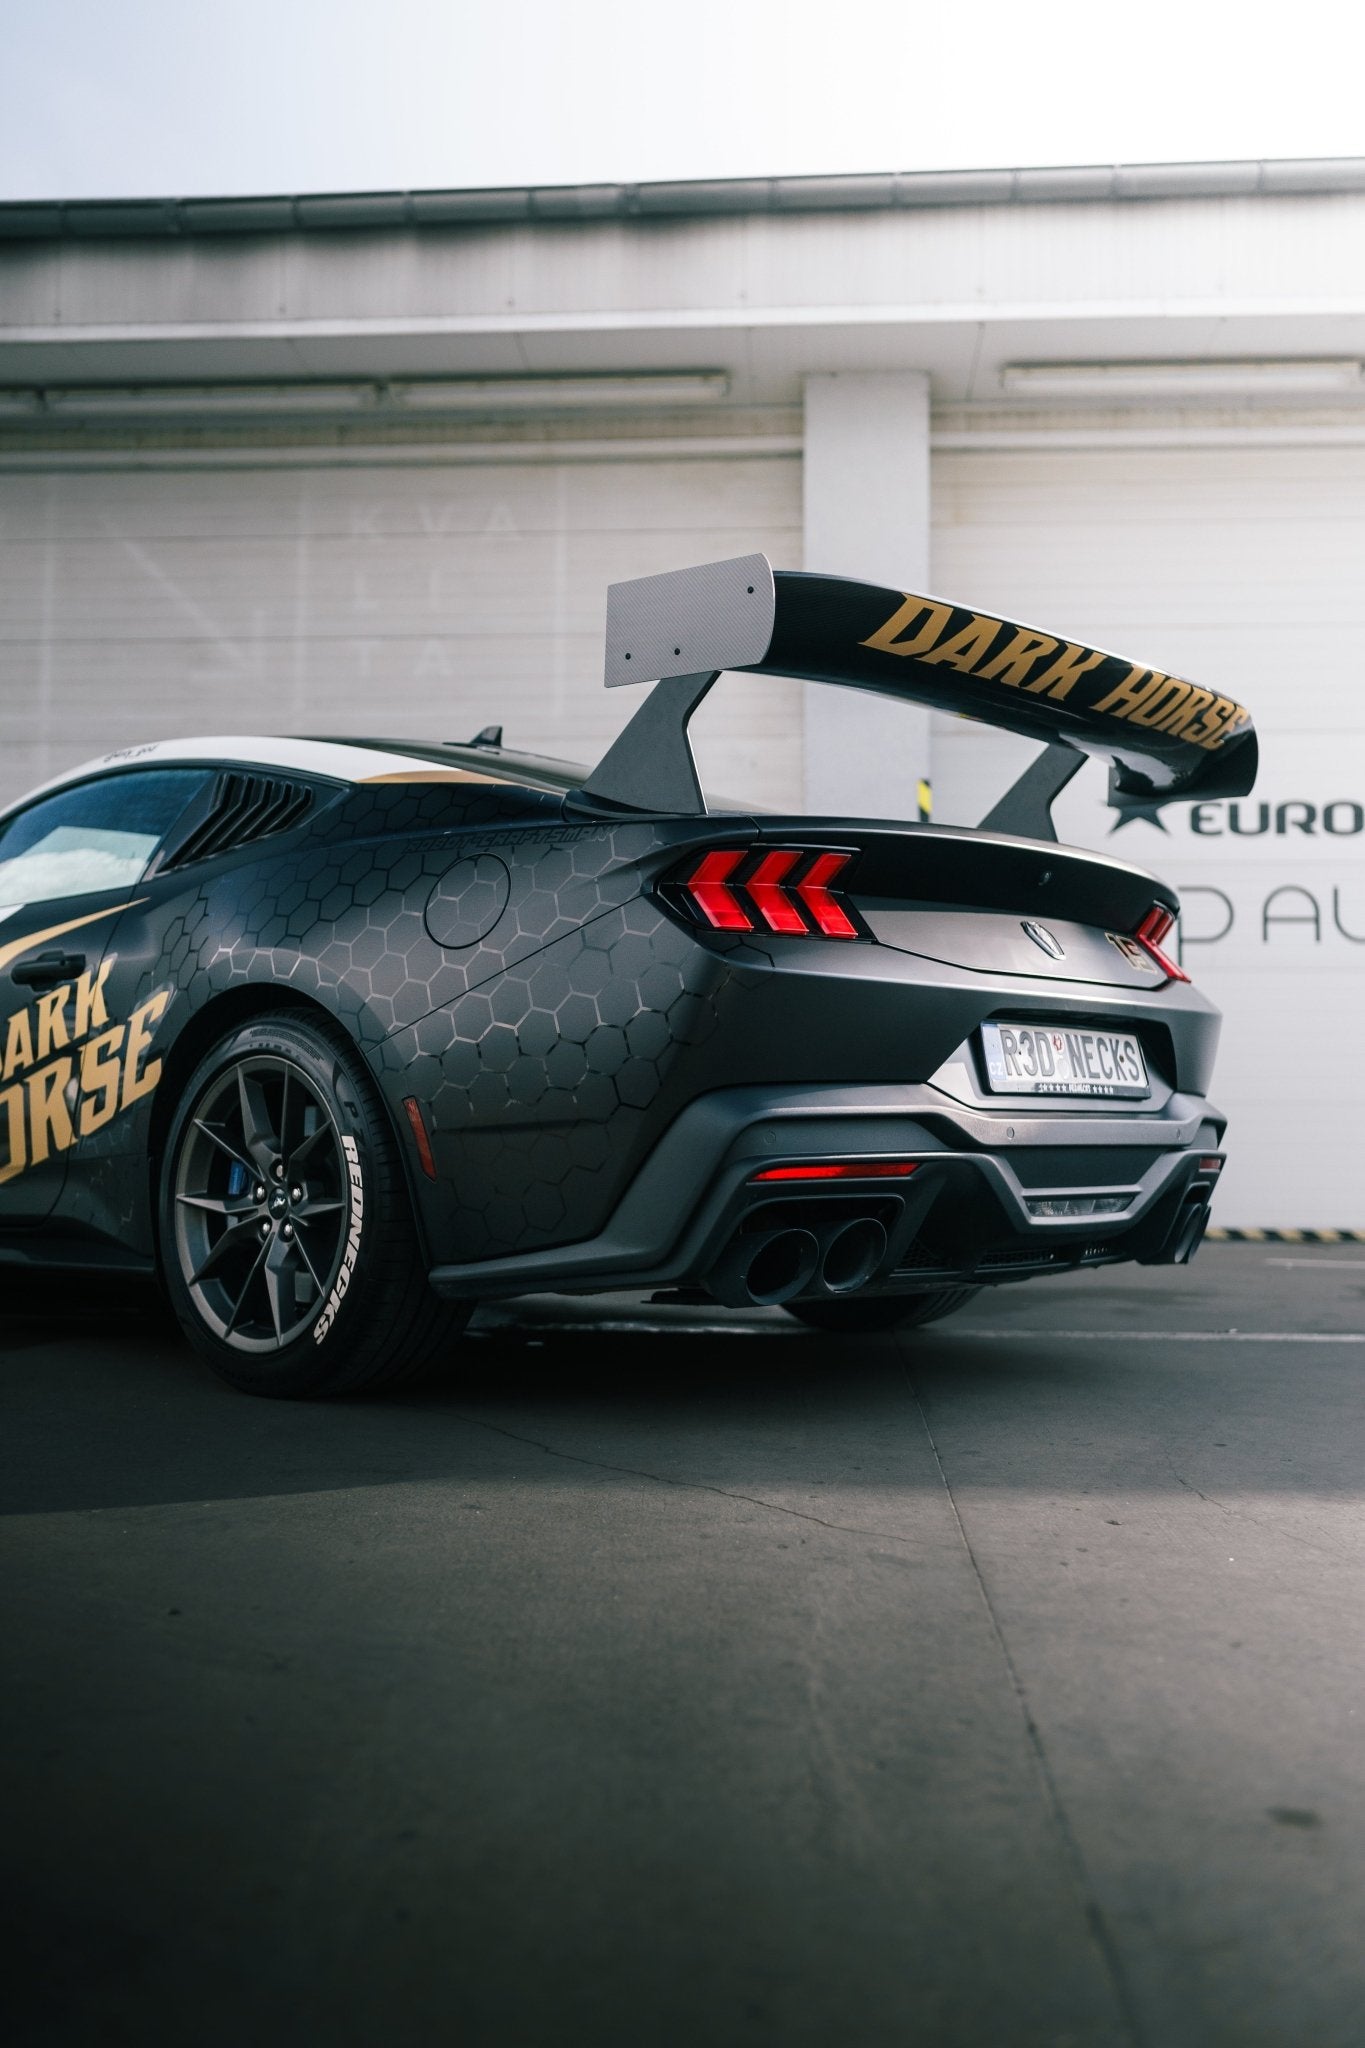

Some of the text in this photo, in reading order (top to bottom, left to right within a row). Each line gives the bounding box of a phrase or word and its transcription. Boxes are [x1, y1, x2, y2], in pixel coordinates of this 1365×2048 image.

[858, 591, 1251, 750] DARK HORSE
[1190, 801, 1364, 836] EURO
[0, 957, 114, 1082] ARK
[1000, 1029, 1140, 1082] R3D NECKS
[313, 1135, 364, 1345] REDNECKS
